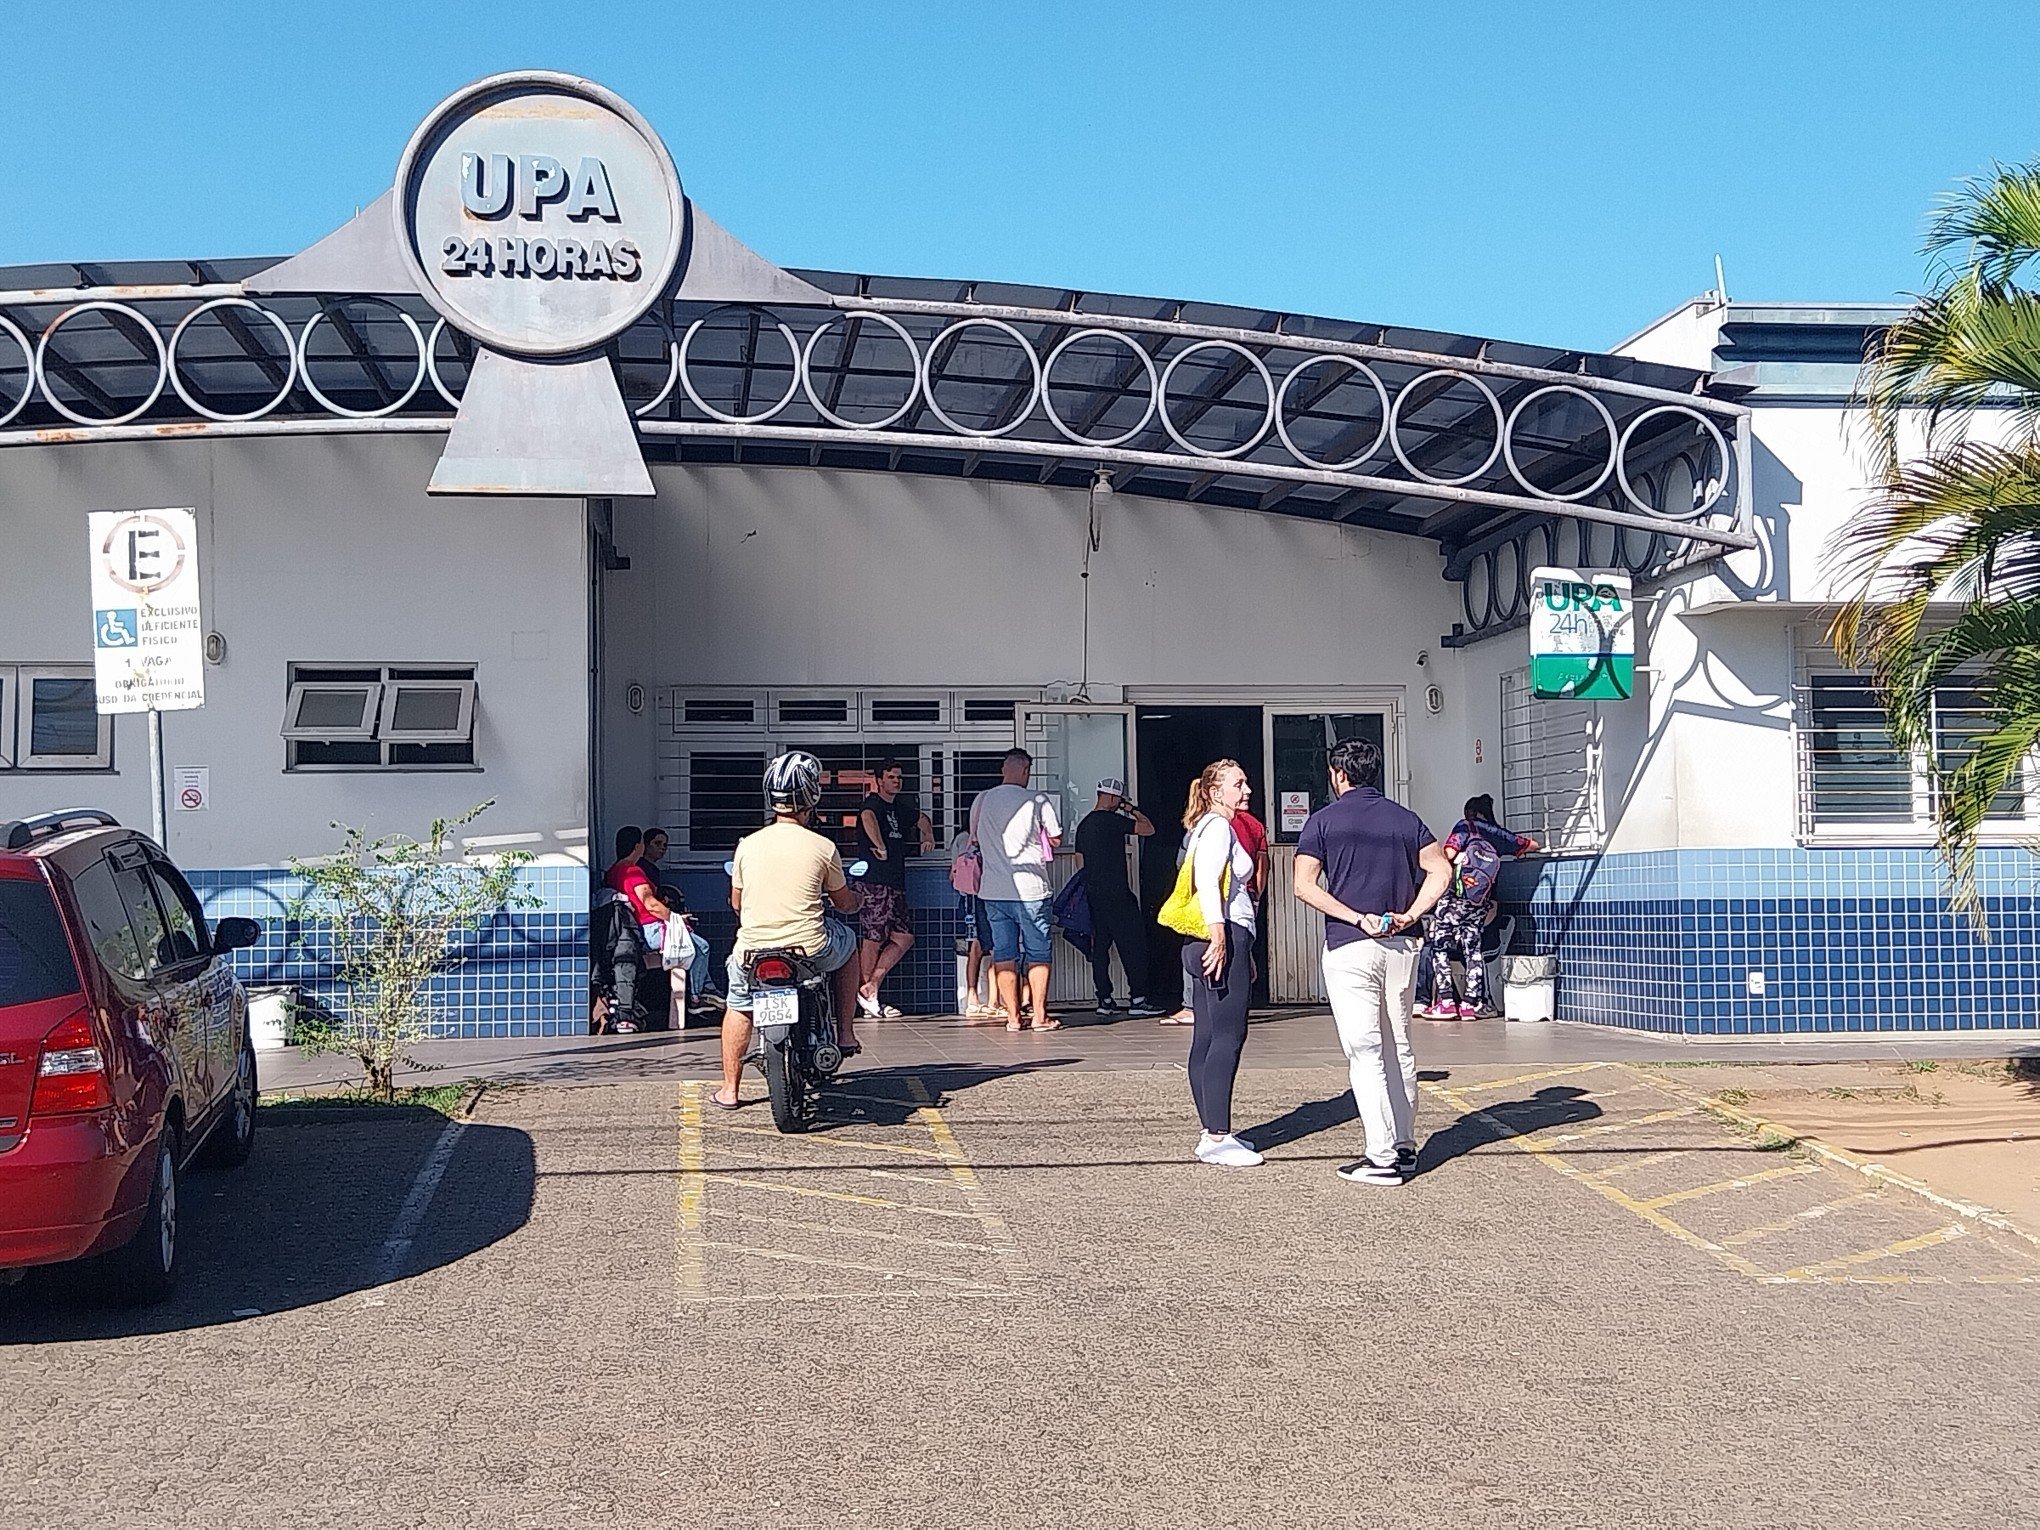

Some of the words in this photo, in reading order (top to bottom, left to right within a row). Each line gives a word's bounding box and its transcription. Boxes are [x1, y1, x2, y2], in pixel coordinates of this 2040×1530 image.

[461, 152, 621, 223] UPA
[442, 236, 495, 278] 24
[498, 237, 642, 282] HORAS
[128, 530, 161, 580] E
[1544, 582, 1624, 612] UPA
[140, 606, 198, 618] EXCLUSIVO
[141, 620, 199, 632] DEFICIENTE
[125, 658, 131, 668] 1
[141, 656, 171, 667] VAGA
[97, 695, 118, 704] USO
[123, 694, 137, 703] DA
[142, 690, 203, 702] CREDENCIAL
[764, 997, 788, 1010] ISK
[760, 1009, 792, 1022] 9G54
